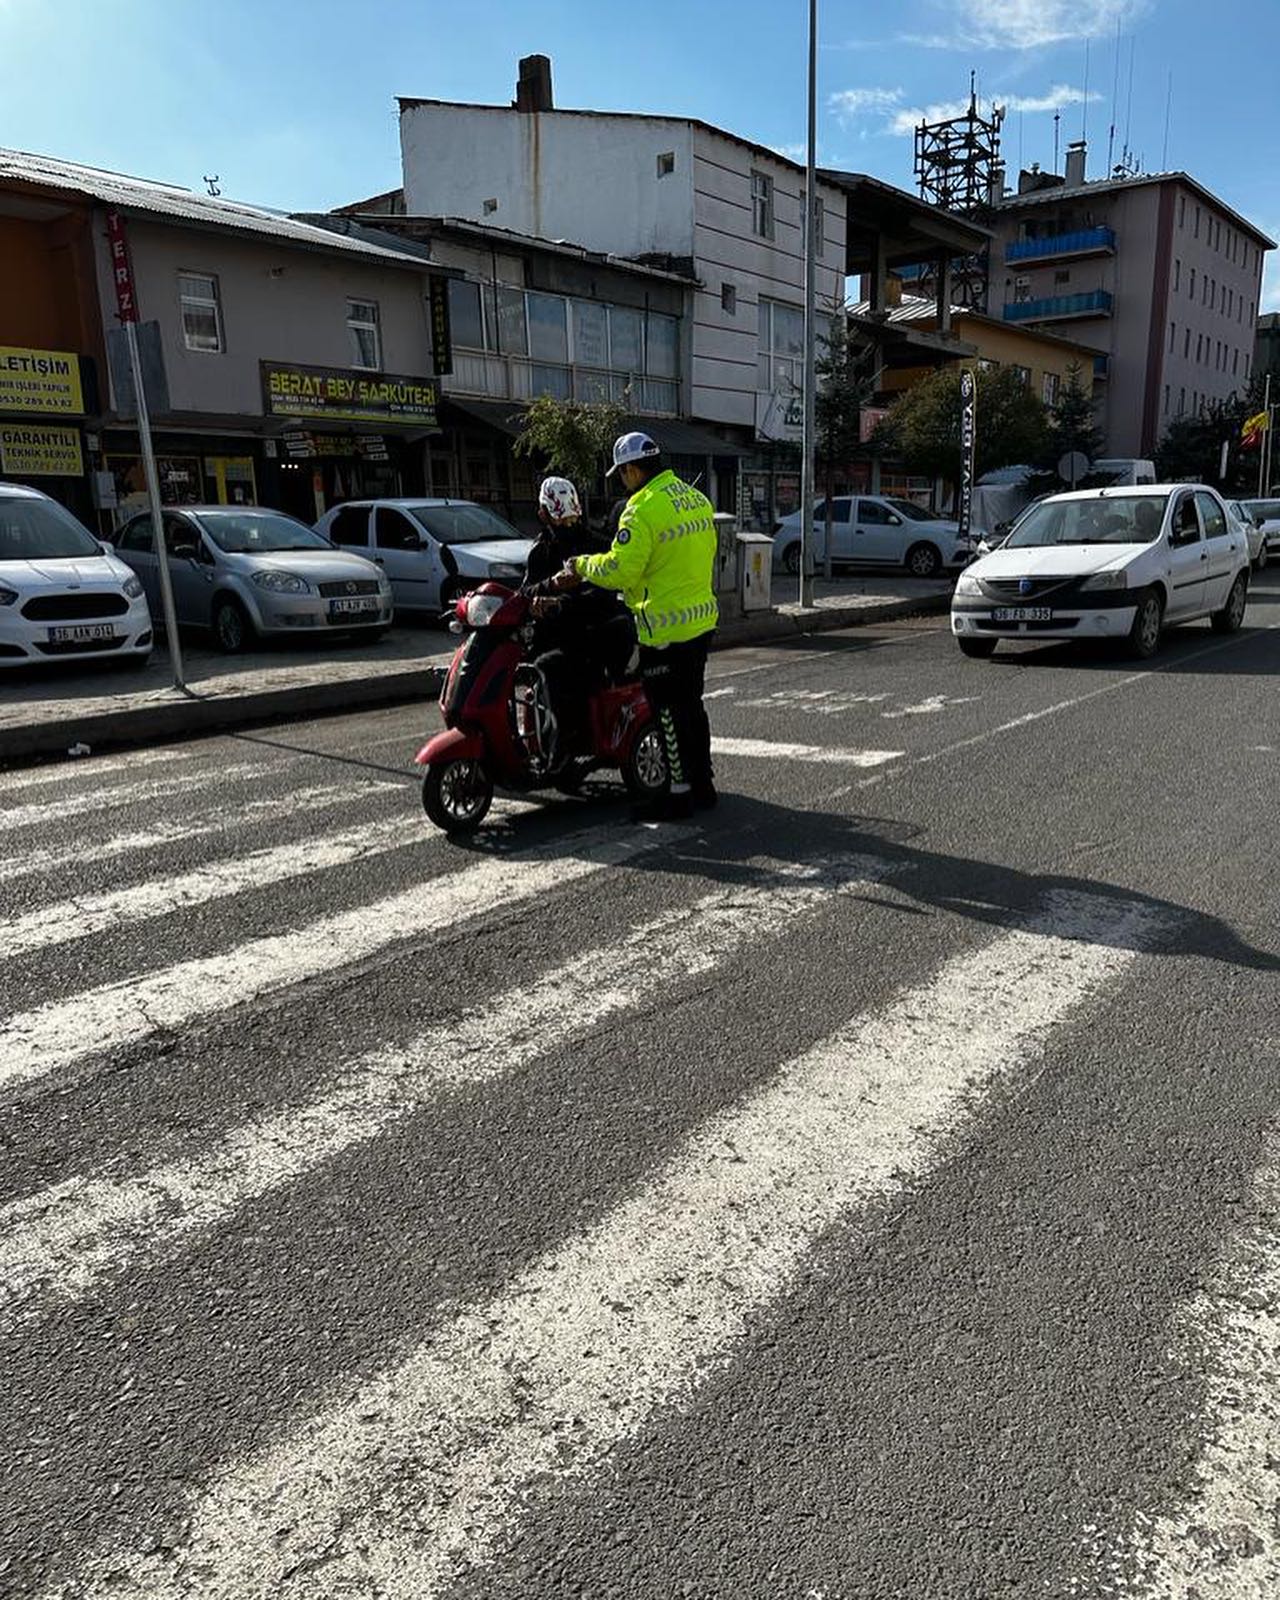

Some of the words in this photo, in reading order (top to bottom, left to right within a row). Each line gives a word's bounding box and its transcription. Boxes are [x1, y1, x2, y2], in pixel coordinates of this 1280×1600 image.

[270, 372, 321, 396] BERAT
[327, 377, 355, 399] BEY
[359, 380, 435, 407] ŞARKÜTERİ
[2, 431, 76, 446] GARANTİLİ
[6, 446, 41, 458] TEKNİK
